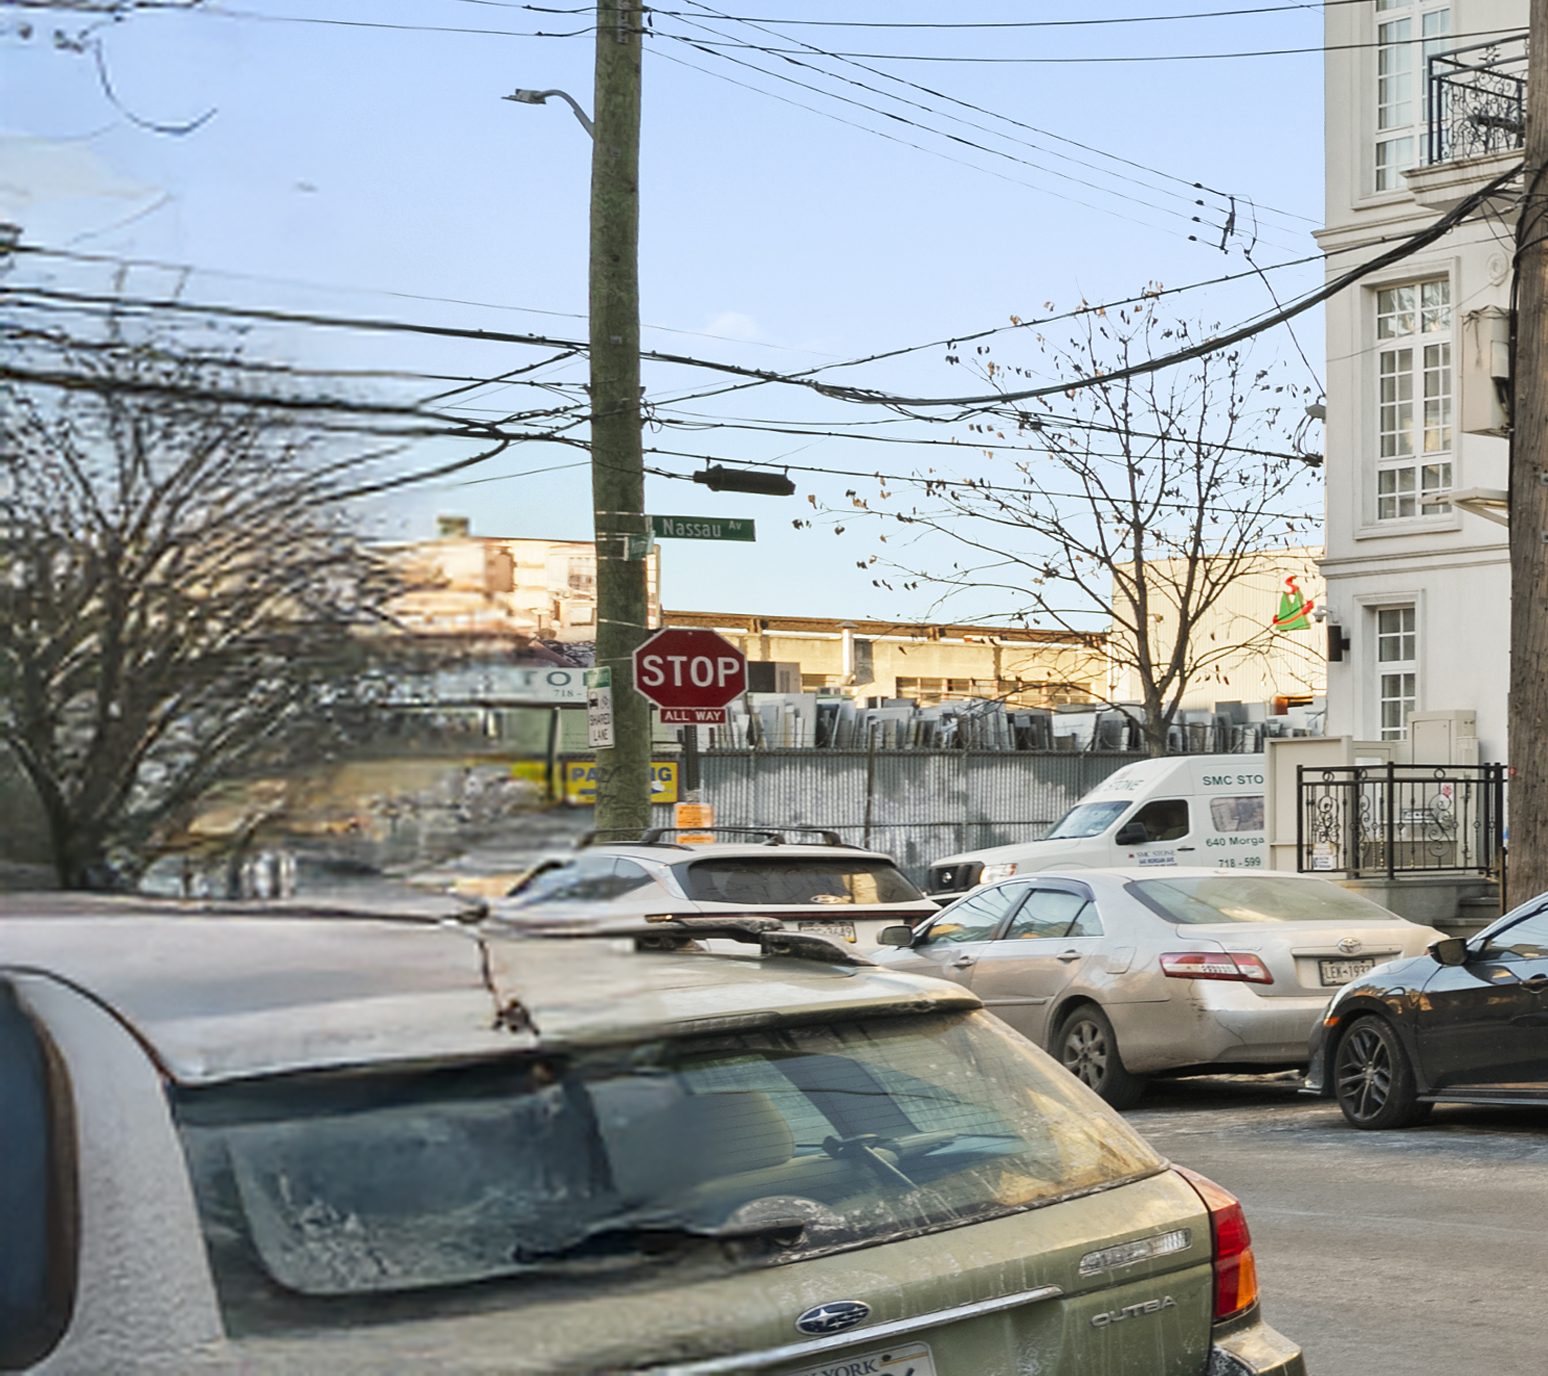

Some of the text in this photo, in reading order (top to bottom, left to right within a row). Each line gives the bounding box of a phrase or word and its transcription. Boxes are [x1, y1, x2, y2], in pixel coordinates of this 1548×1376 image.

[662, 518, 742, 538] Nassau Av
[642, 655, 740, 687] STOP
[664, 711, 721, 721] ALL WAY
[1203, 774, 1264, 786] SMC STO
[1206, 836, 1265, 847] 640 Morga
[1219, 859, 1235, 867] 718
[1245, 857, 1261, 866] 599
